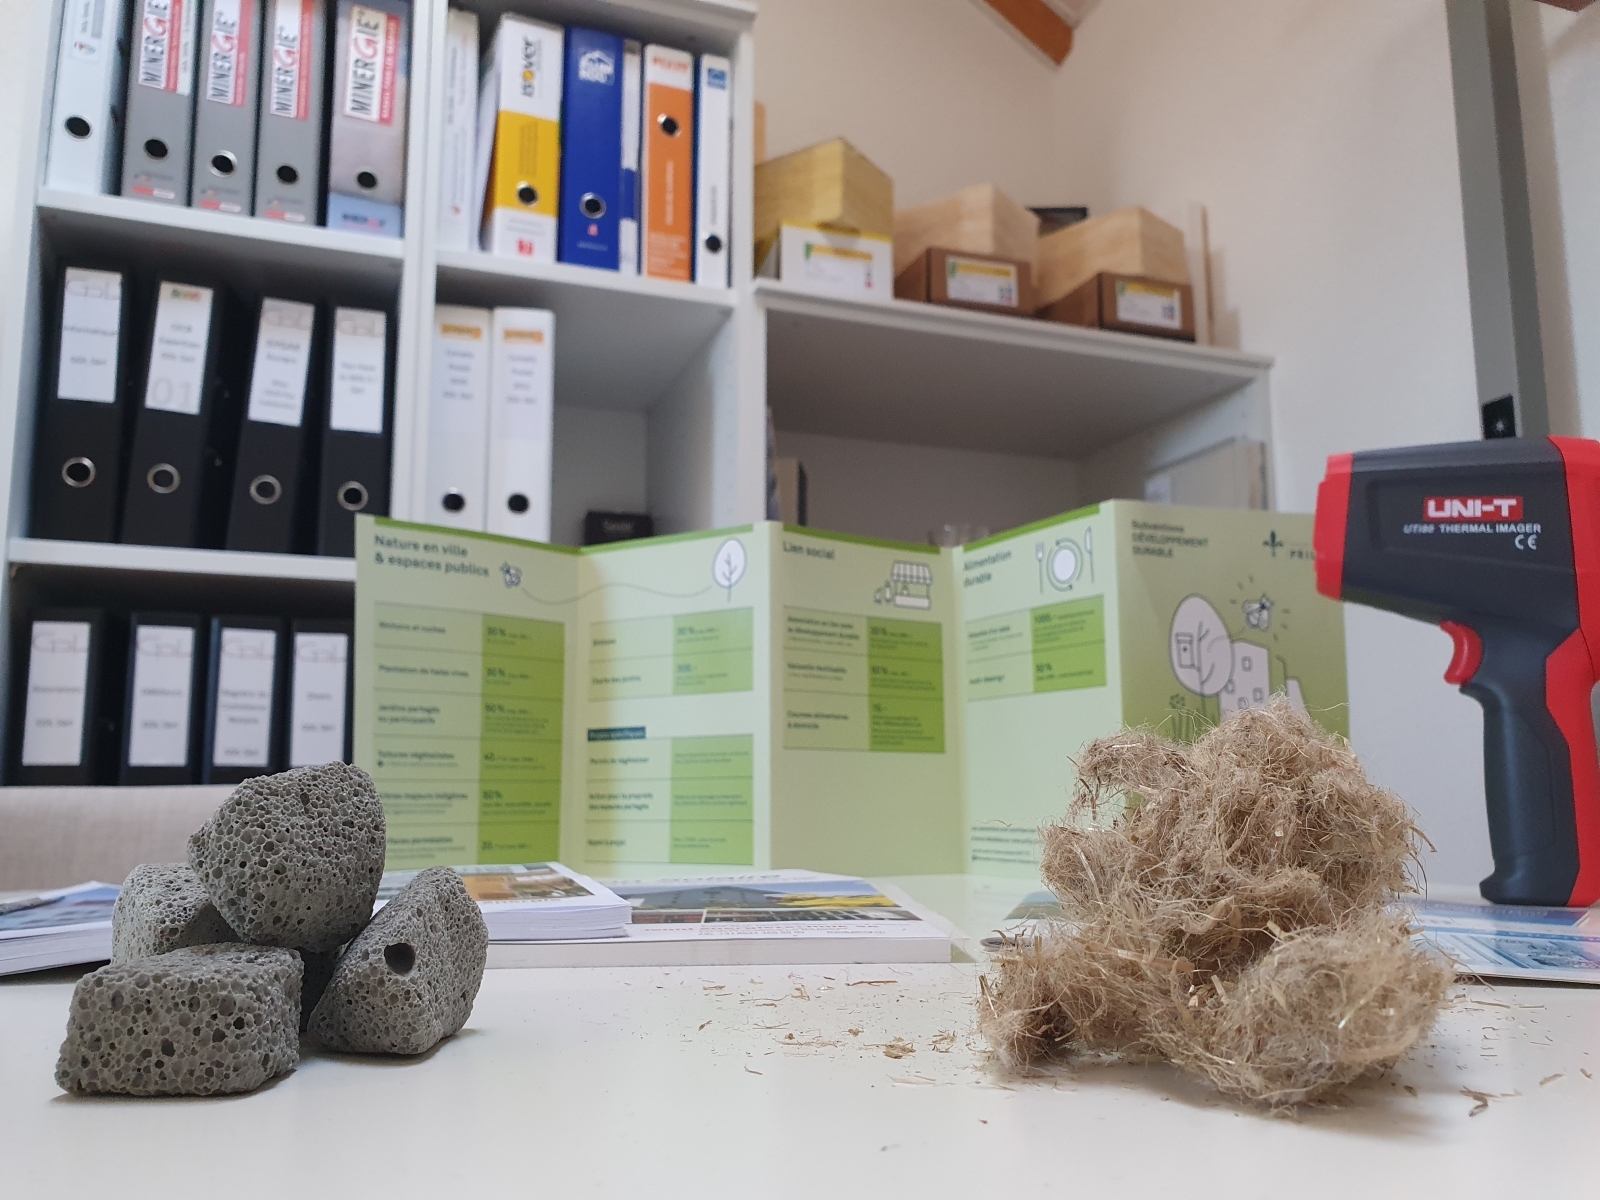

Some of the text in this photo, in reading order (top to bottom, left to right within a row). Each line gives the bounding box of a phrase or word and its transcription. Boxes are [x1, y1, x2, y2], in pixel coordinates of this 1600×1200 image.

[211, 15, 238, 97] MINERGIE
[350, 18, 379, 115] MINERGIE
[273, 29, 298, 113] MINERGIE
[1427, 499, 1517, 518] UNI-T
[1439, 523, 1493, 534] THERMAL
[1496, 523, 1541, 534] IMAGER
[374, 535, 468, 557] Nature en ville
[374, 552, 490, 577] & espaces publics
